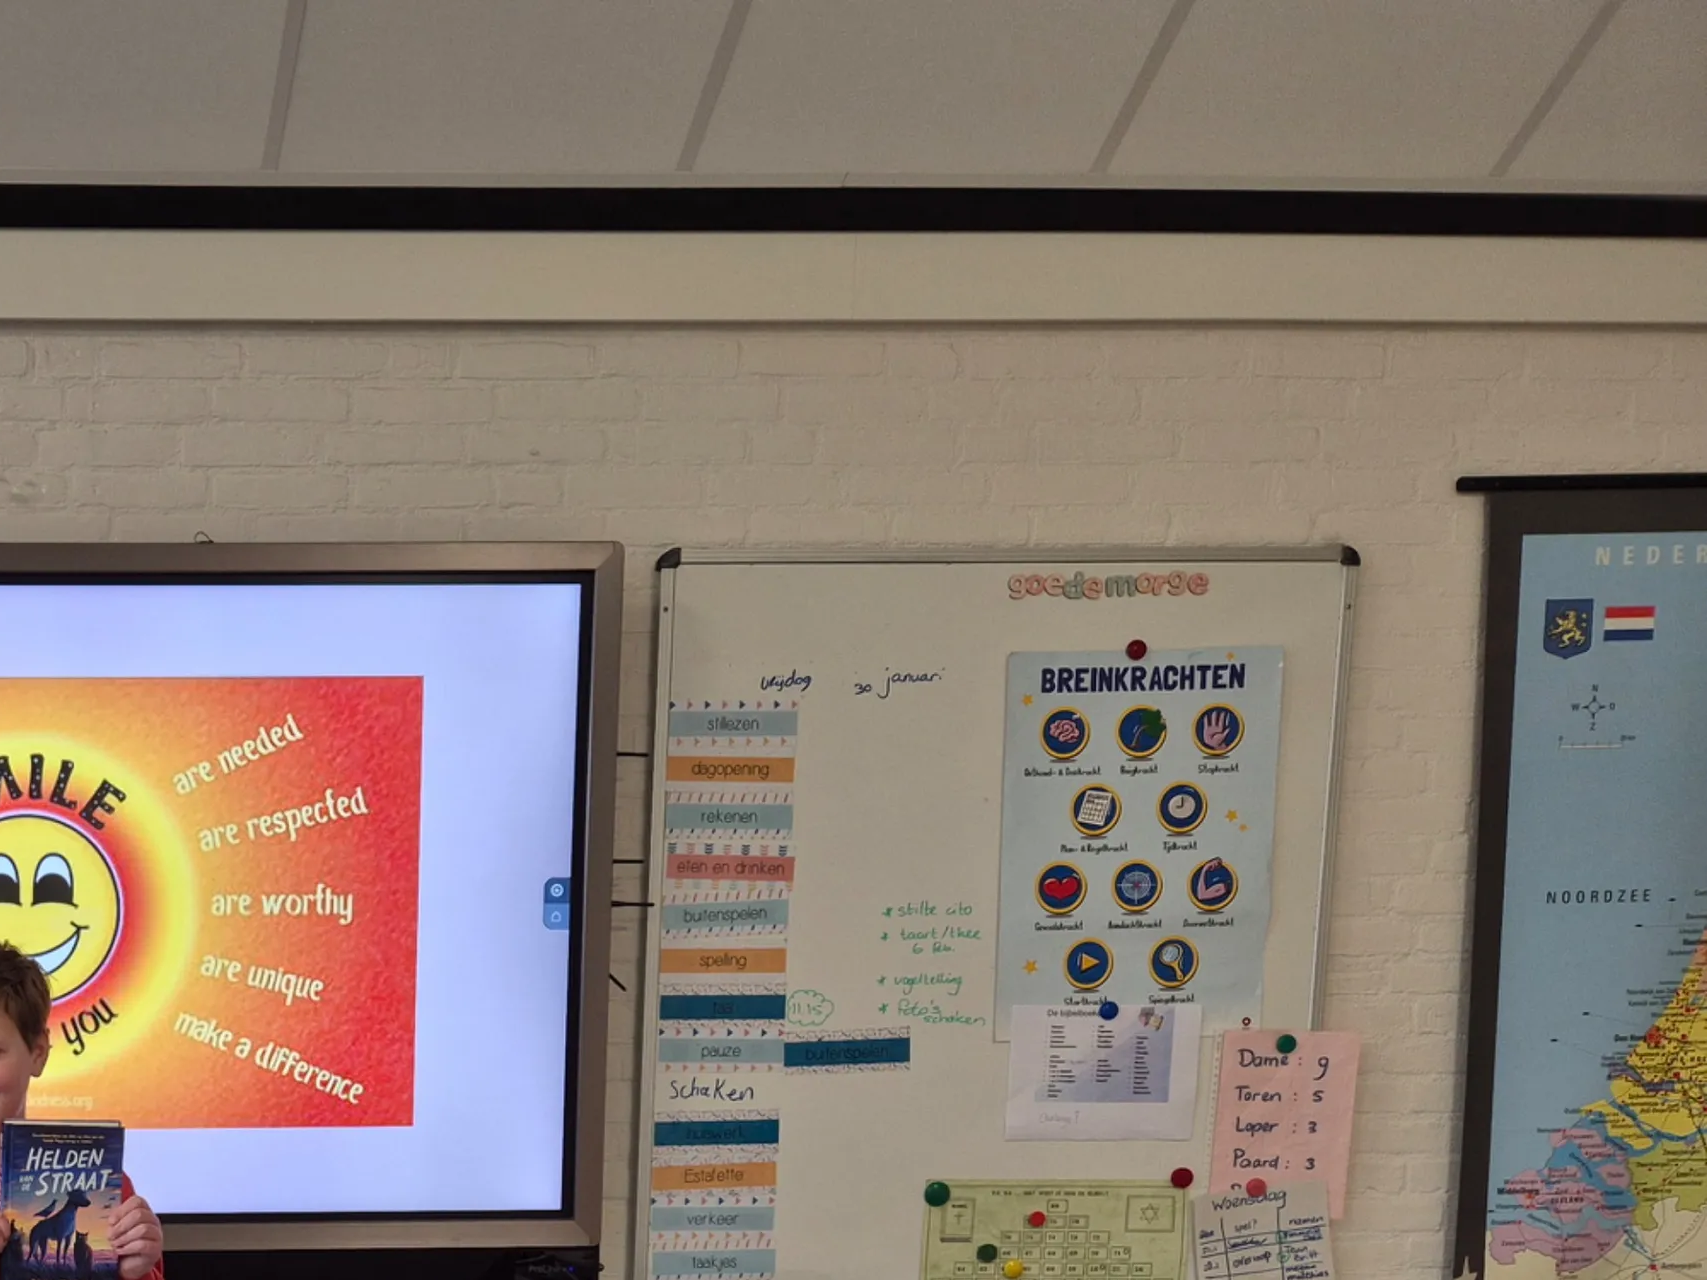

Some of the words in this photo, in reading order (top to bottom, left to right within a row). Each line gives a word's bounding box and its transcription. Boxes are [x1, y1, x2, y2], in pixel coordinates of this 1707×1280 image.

[1041, 663, 1246, 694] BREINKRACHTEN
[854, 683, 873, 696] 30
[707, 716, 760, 732] stillezen
[172, 762, 214, 795] are
[217, 713, 304, 776] needed
[692, 759, 770, 781] dagopening
[199, 821, 239, 853] are
[246, 786, 369, 842] respected
[700, 809, 758, 825] rekenen
[677, 860, 709, 875] eten
[712, 862, 731, 875] en
[734, 860, 786, 877] drinken
[212, 889, 251, 916] are
[261, 883, 354, 926] worthy
[1546, 888, 1653, 904] NOORDZEE
[683, 907, 768, 925] buitenspelen
[699, 952, 748, 971] spelling
[201, 953, 241, 982] are
[248, 965, 325, 1006] unique
[60, 996, 119, 1056] you
[174, 1011, 232, 1053] make
[234, 1037, 252, 1060] a
[254, 1041, 365, 1105] difference
[701, 1045, 742, 1060] pauze
[1312, 1089, 1324, 1103] 5
[25, 1146, 105, 1172] HELDEN
[1304, 1157, 1316, 1171] 3
[35, 1168, 113, 1196] STRAAT
[684, 1167, 745, 1184] Estafette
[686, 1212, 740, 1226] verkeer
[692, 1254, 738, 1271] taakjes
